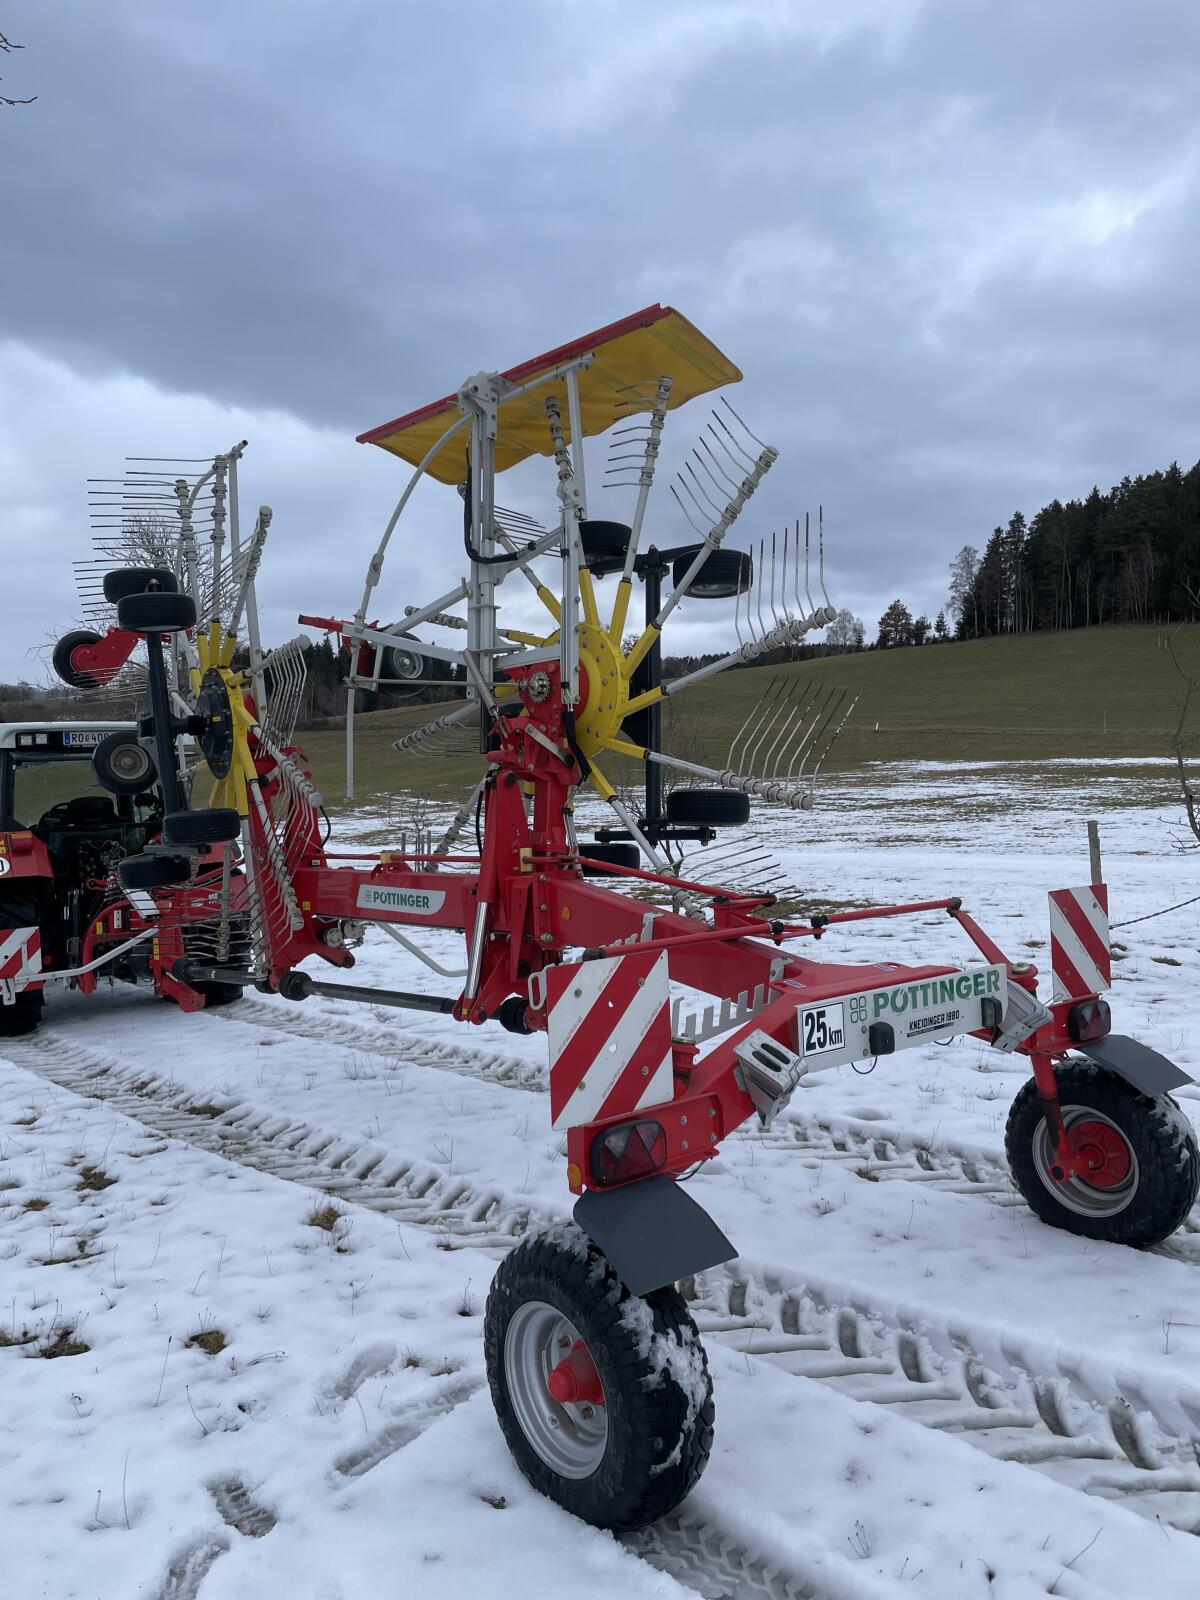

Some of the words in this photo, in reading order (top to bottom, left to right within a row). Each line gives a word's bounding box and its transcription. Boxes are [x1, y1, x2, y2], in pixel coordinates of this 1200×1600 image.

[373, 891, 430, 909] PÖTTINGER
[873, 969, 1001, 1018] PÖTTINGER
[804, 1010, 828, 1051] 25
[828, 1028, 844, 1045] km
[909, 1013, 946, 1031] KNEIDINGER
